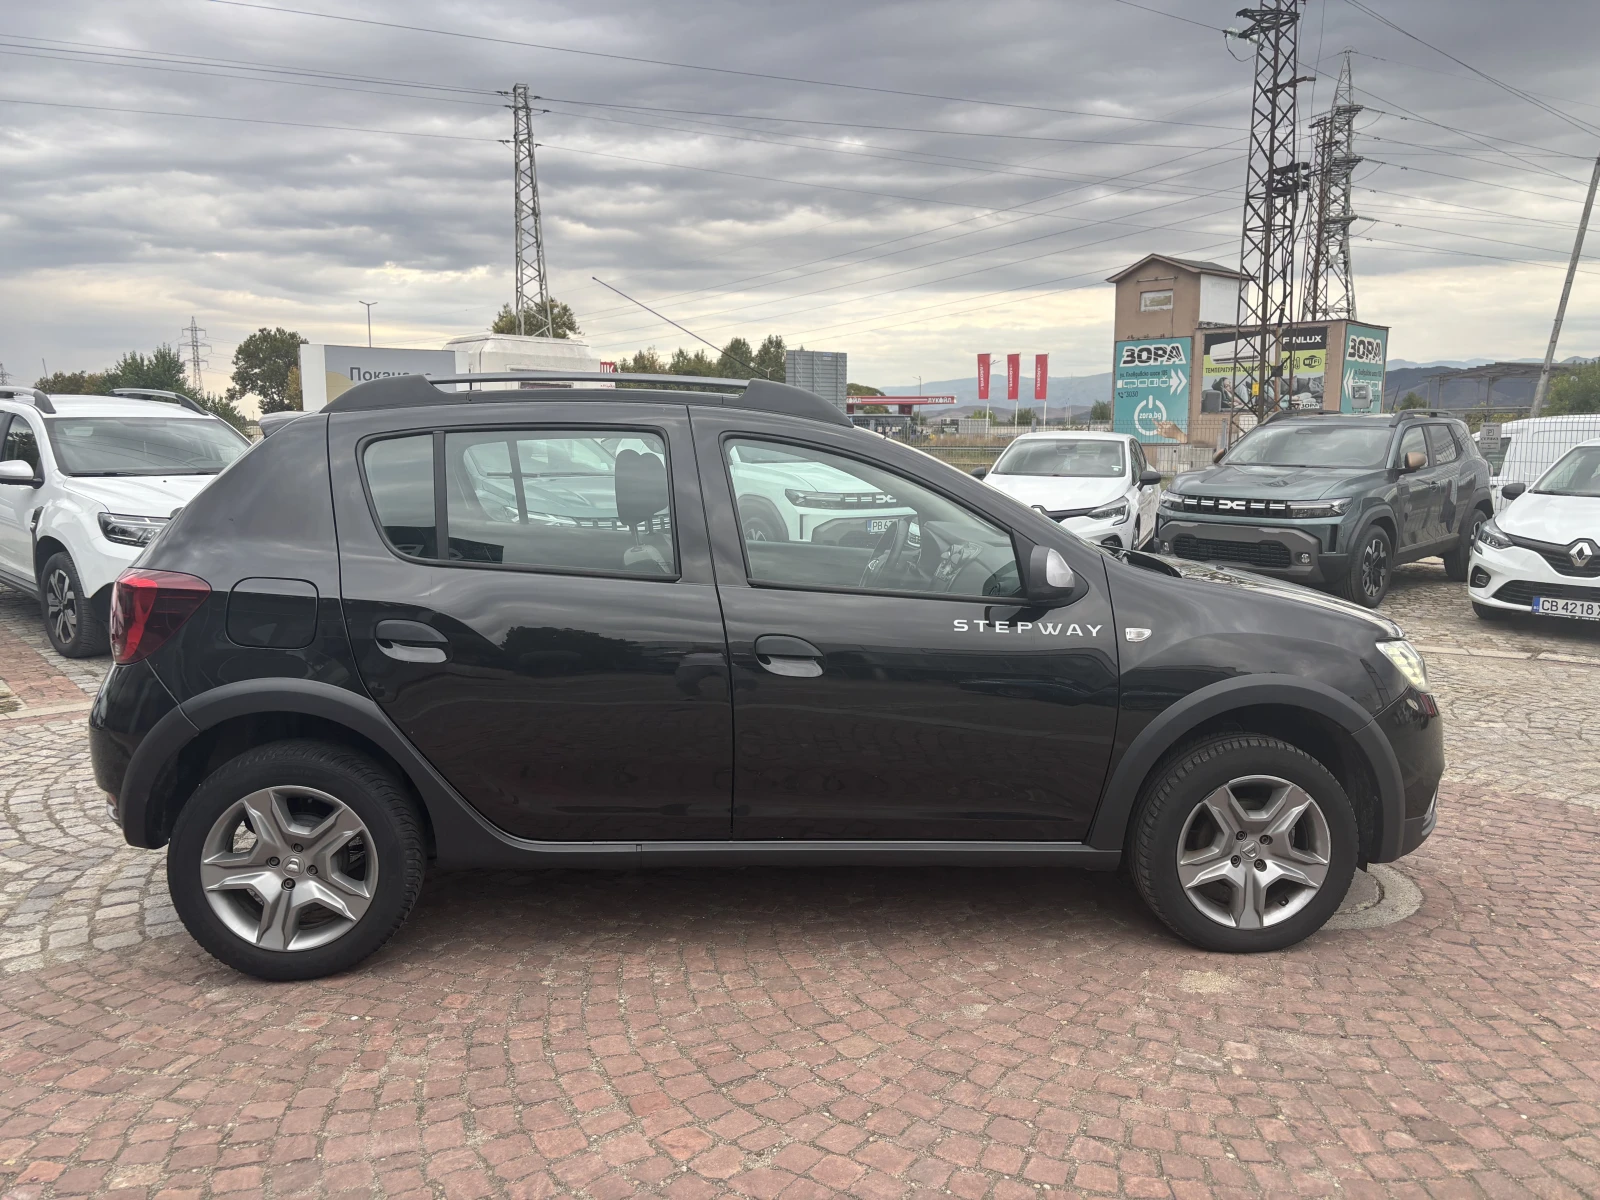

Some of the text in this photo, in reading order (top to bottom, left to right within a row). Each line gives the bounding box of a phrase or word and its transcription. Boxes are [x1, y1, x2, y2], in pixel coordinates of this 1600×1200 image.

[1283, 335, 1322, 344] FNLUX
[1121, 344, 1185, 366] ЗОРА
[1347, 336, 1383, 364] ЗОРА
[1139, 411, 1162, 420] zora.bg
[873, 521, 883, 530] PB
[1541, 599, 1559, 612] CB
[1561, 601, 1594, 615] 4218
[953, 619, 1103, 637] STEPWAY
